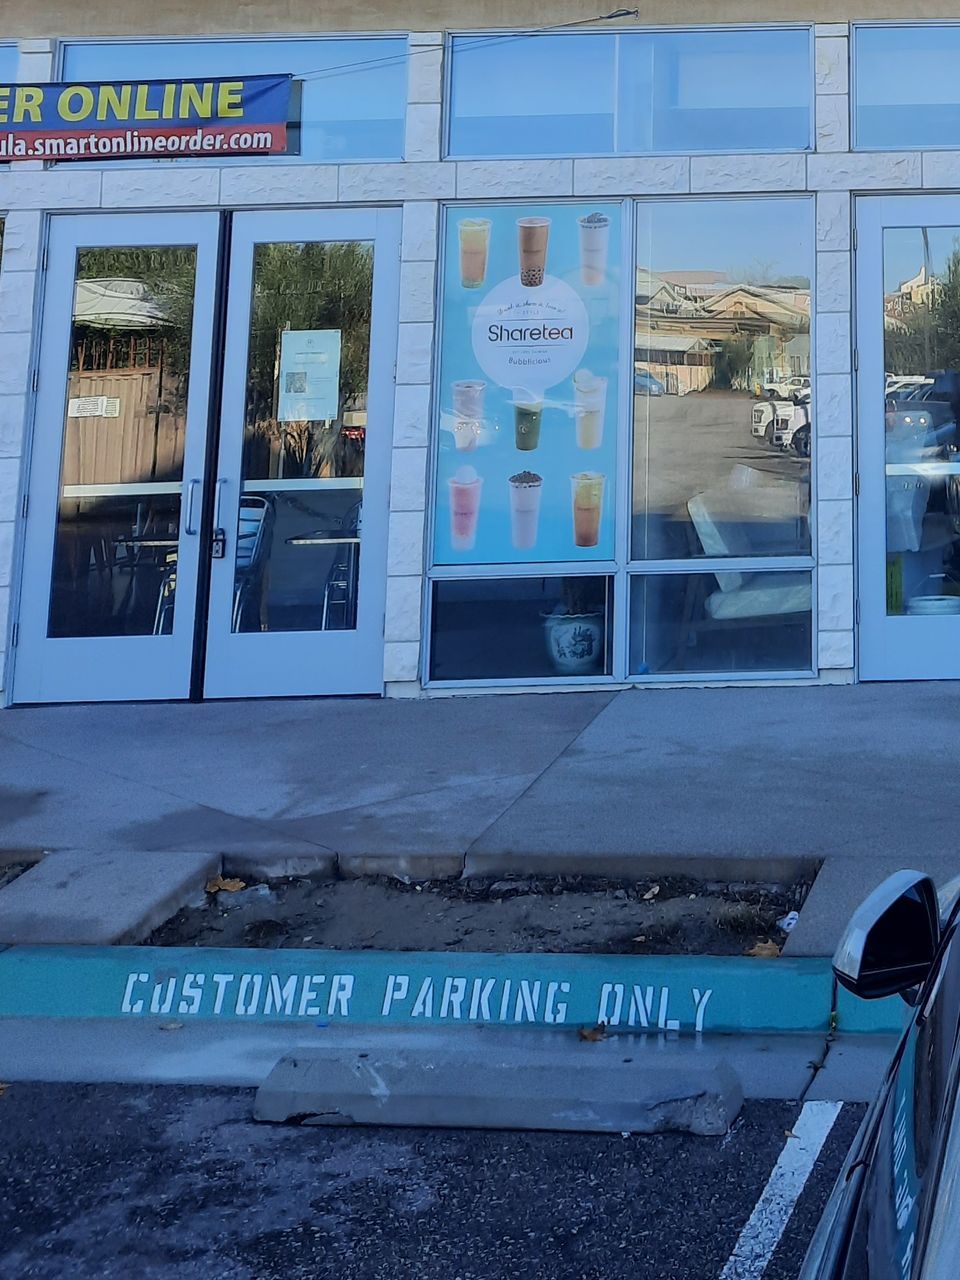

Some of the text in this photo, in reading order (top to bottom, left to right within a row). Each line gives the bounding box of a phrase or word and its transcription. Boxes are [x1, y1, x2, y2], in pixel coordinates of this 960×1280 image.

[57, 81, 244, 121] ONLINE
[488, 323, 573, 342] Sharetea
[121, 972, 714, 1032] CUSTOMER PARKING ONLY
